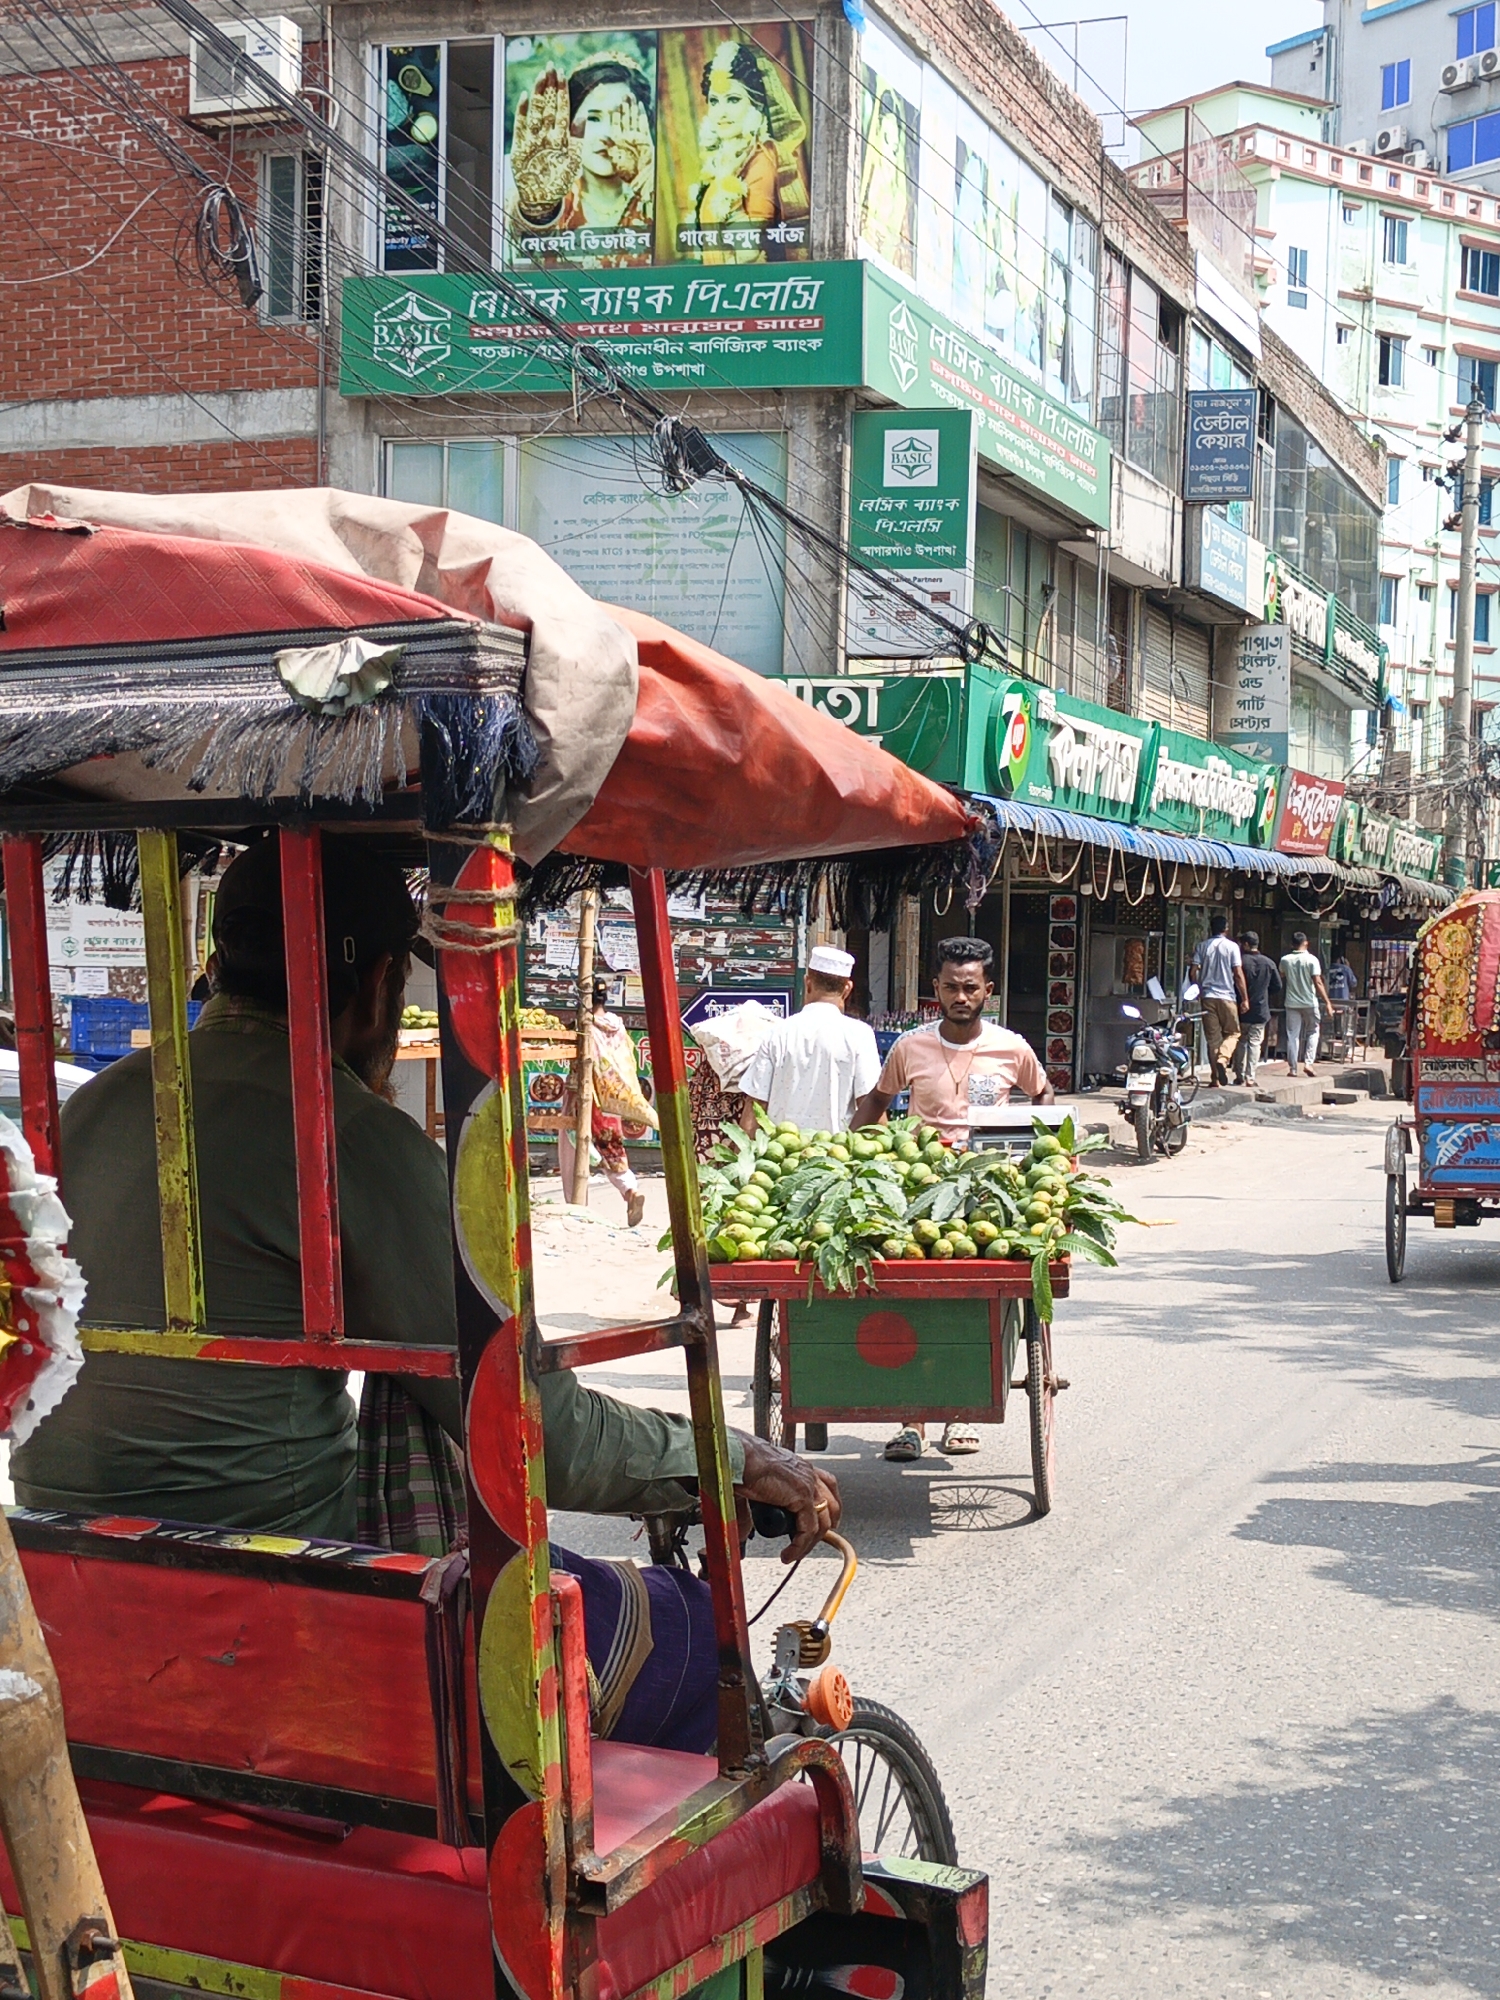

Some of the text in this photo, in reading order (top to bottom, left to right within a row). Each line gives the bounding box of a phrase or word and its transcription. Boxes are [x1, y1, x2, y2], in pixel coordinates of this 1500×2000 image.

[521, 227, 651, 252] মেহেদী ডিজাইন
[679, 229, 718, 248] গায়ে
[721, 227, 762, 248] হলুদ
[578, 284, 675, 316] ব্যাংক
[683, 275, 825, 314] পিএলসি
[373, 322, 451, 346] BASIC
[577, 322, 632, 336] পথে
[642, 319, 745, 335] মানুষের
[755, 317, 823, 331] সাথে
[688, 335, 769, 354] বাণিজ্যিক
[772, 337, 824, 353] ব্যাংক
[889, 328, 919, 366] BASIC
[652, 361, 706, 377] উপশাখা
[929, 322, 1098, 461] বেসিক ব্যাংক পিএলসি
[988, 399, 1017, 424] পথে
[1193, 411, 1250, 432] ডেন্টাল
[1195, 433, 1247, 451] কেয়ার
[891, 452, 933, 464] BASIC
[583, 491, 618, 506] বেসিক
[858, 497, 961, 513] বেসিক ব্যাংক
[874, 517, 944, 534] পিএলসি
[601, 547, 623, 556] RTGS
[915, 543, 957, 558] উপশাখা
[912, 576, 943, 584] Partners
[679, 623, 695, 632] SMS
[1238, 677, 1264, 689] এন্ড
[1236, 694, 1266, 711] পার্টি
[1048, 711, 1144, 805] কলাপাতা
